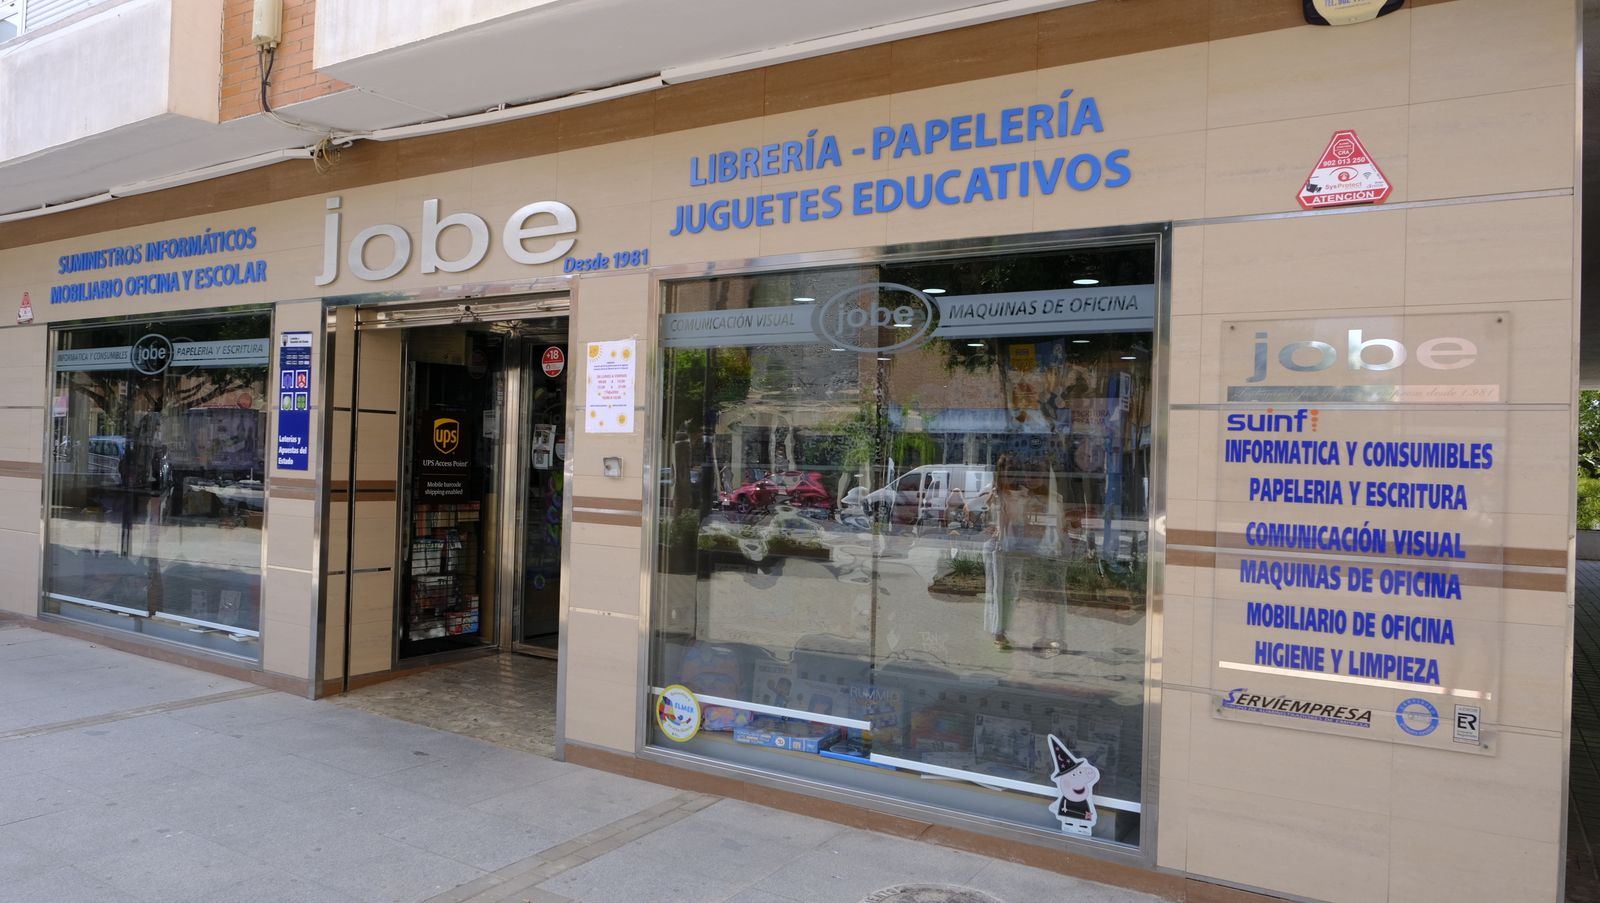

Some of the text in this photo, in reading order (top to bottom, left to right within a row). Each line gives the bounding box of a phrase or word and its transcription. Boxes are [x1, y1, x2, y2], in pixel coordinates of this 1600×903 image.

[690, 130, 842, 187] LIBRERÍA
[872, 89, 1104, 161] PAPELERÍA
[669, 149, 1132, 236] JUGUETES EDUCATIVOS
[58, 227, 257, 275] SUMINISTROS INFORMÁTICOS
[314, 196, 578, 287] jobe
[563, 248, 649, 273] Desde 1981
[50, 278, 123, 304] MOBILIARIO
[125, 272, 180, 297] OFICINA
[182, 269, 194, 291] Y
[195, 260, 267, 289] ESCOLAR
[670, 312, 796, 333] COMUNICACIÓN VISUAL
[835, 300, 915, 335] jobe
[949, 295, 1139, 321] MAQUINAS DE OFICINA
[137, 345, 166, 364] jobe
[222, 343, 263, 355] ESCRITURA
[1246, 329, 1478, 383] jobe
[435, 429, 457, 448] ups
[1225, 439, 1494, 470] INFORMATICA Y CONSUMIBLES
[422, 459, 434, 467] UPS
[434, 460, 453, 468] Access
[1250, 477, 1468, 511] PAPELERIA Y ESCRITURA
[1246, 521, 1466, 559] COMUNICACIÓN VISUAL
[1240, 559, 1462, 600] MAQUINAS DE OFICINA
[1247, 602, 1455, 645] MOBILIARIO DE OFICINA
[1255, 641, 1440, 685] HIGIENE Y LIMPIEZA
